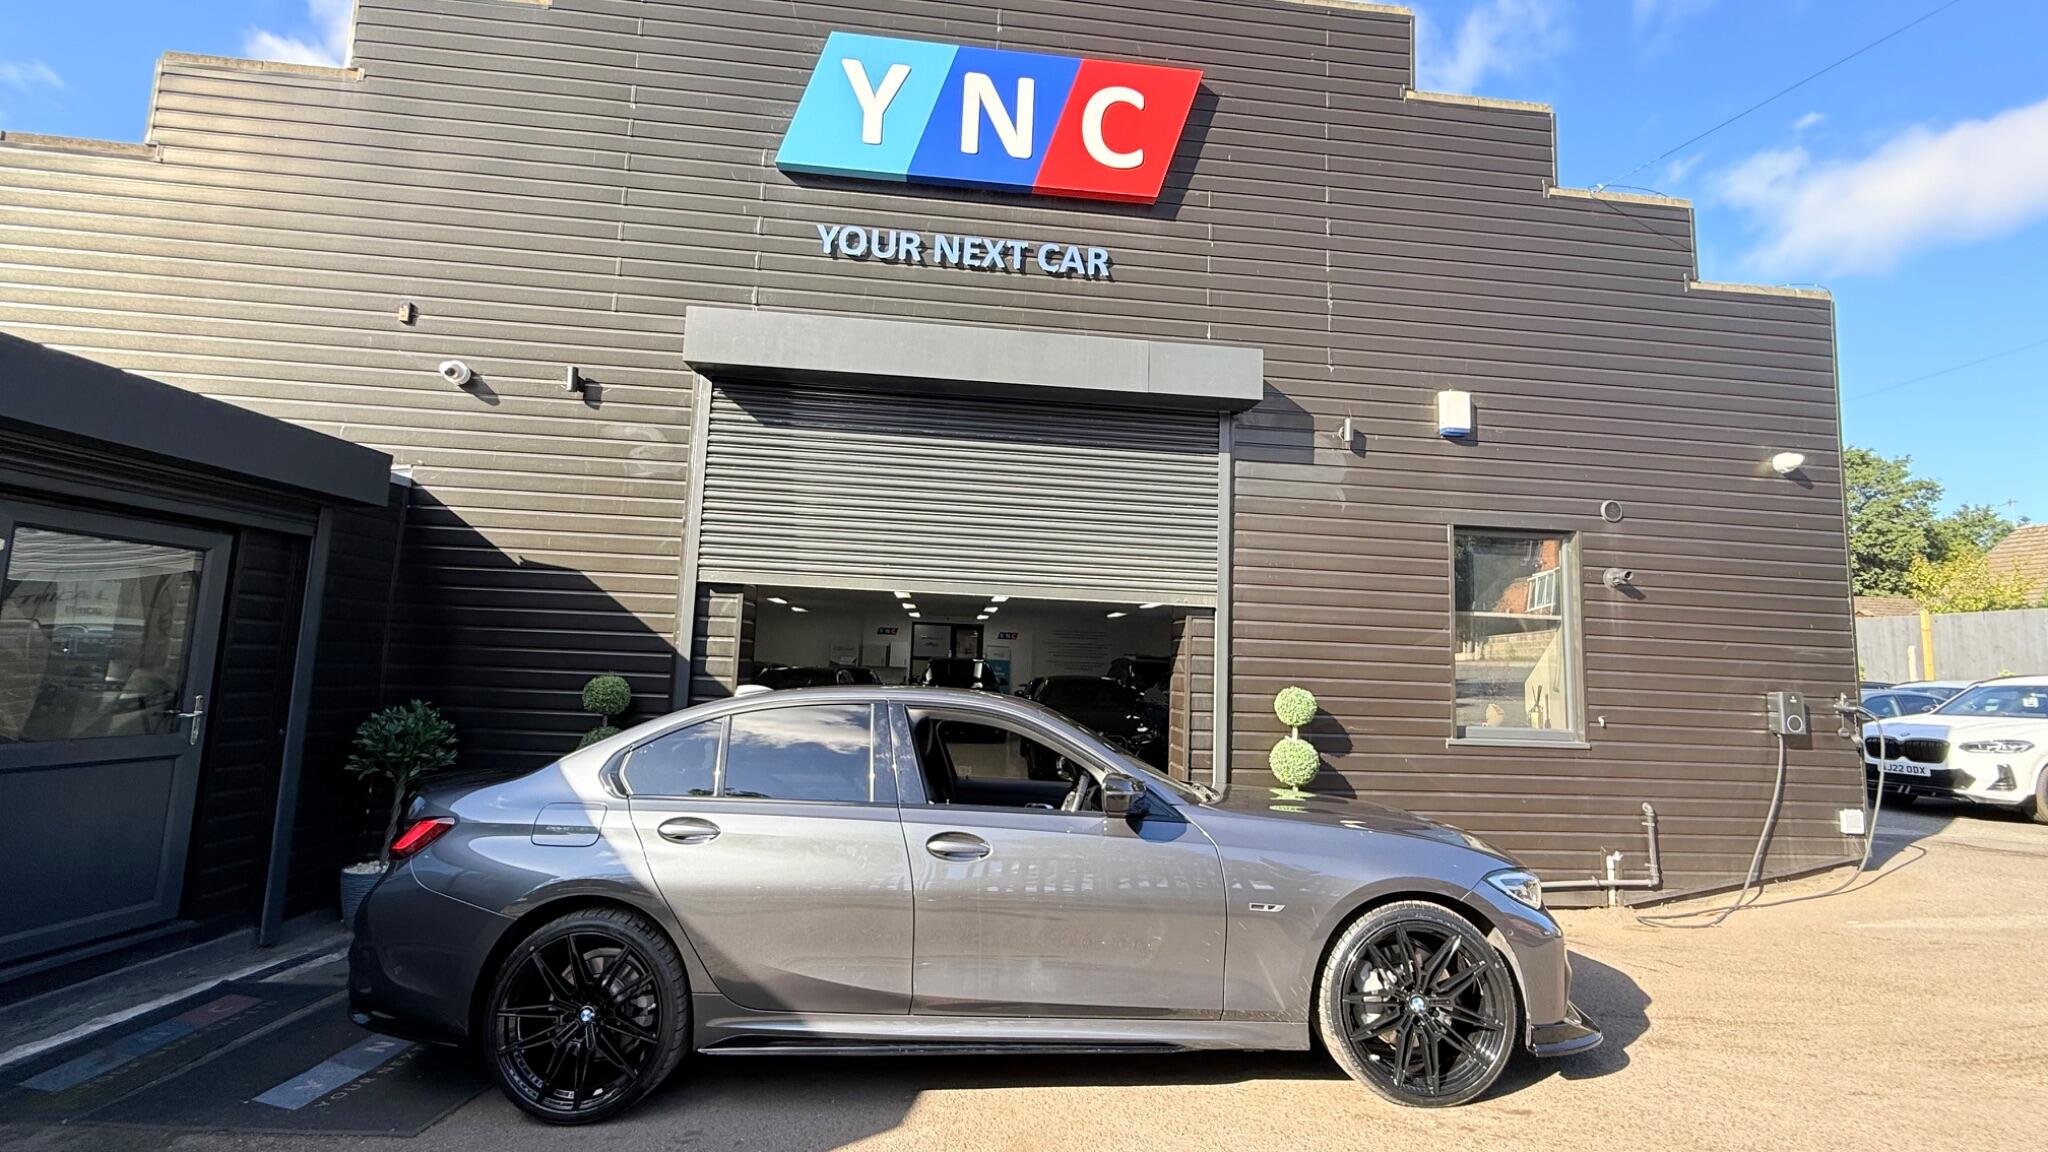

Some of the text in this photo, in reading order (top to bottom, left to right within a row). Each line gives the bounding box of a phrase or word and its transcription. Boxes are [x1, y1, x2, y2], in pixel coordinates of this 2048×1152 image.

[841, 57, 1145, 170] YNC
[815, 223, 1111, 277] YOUR NEXT CAR
